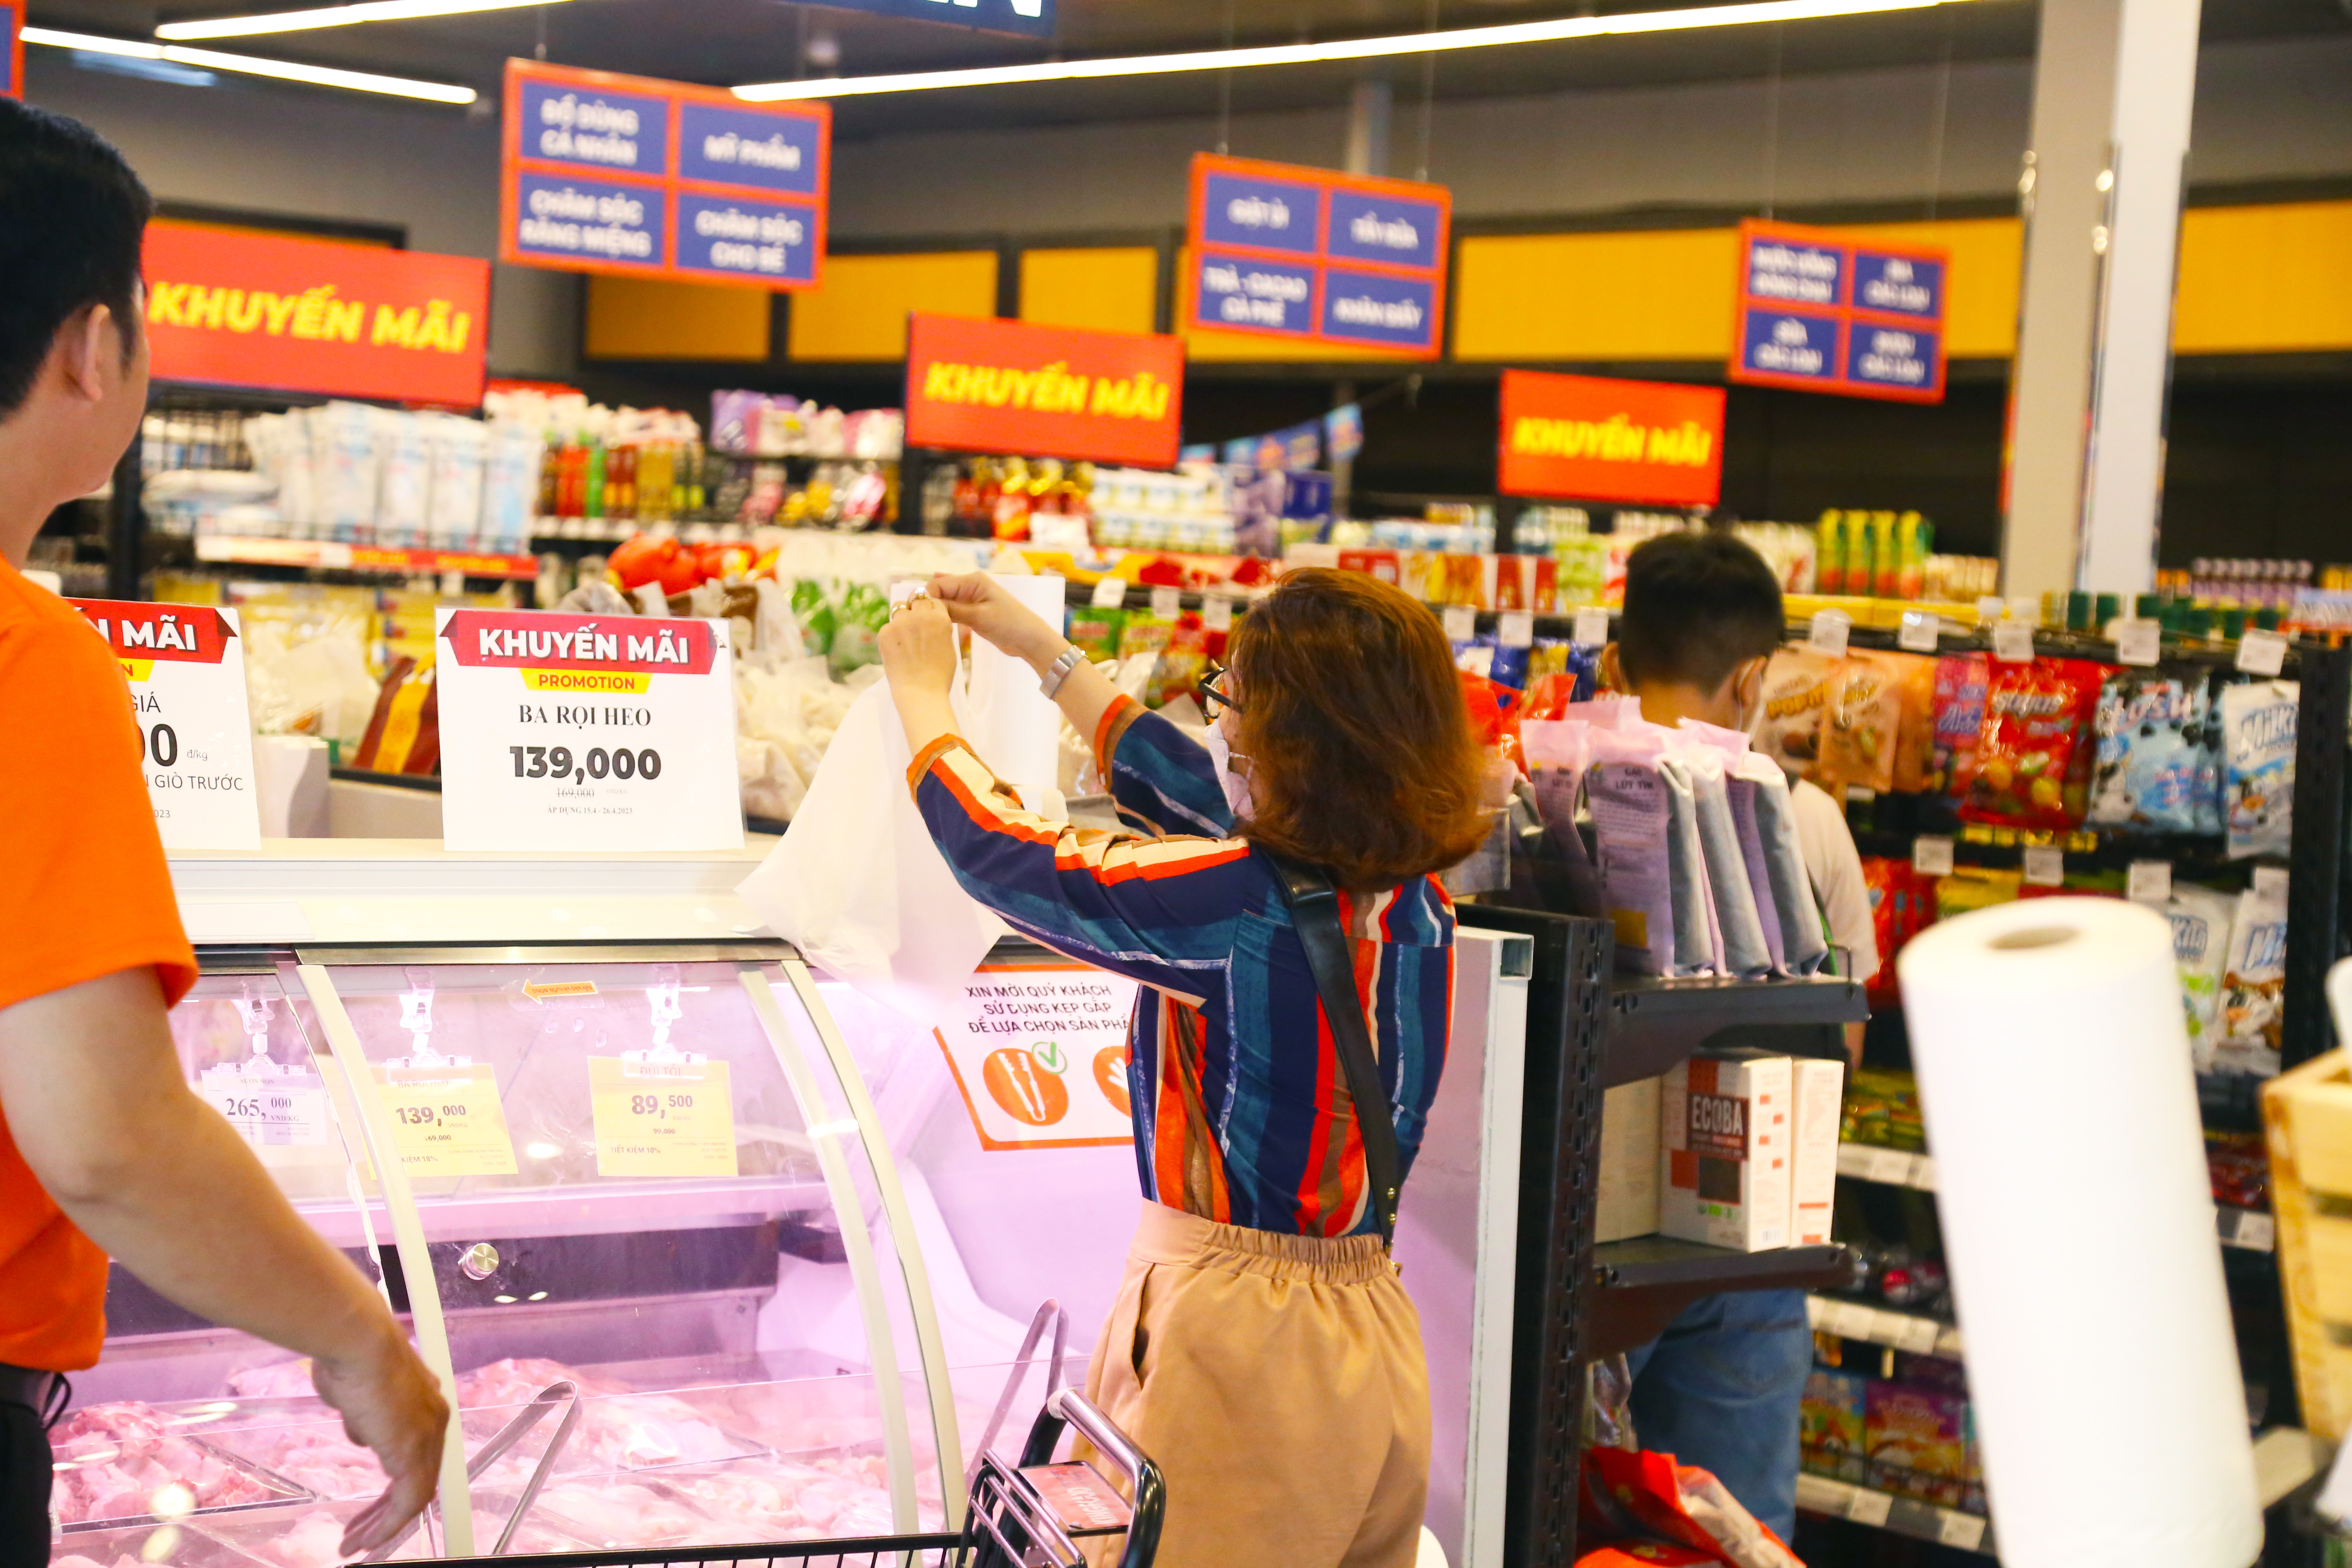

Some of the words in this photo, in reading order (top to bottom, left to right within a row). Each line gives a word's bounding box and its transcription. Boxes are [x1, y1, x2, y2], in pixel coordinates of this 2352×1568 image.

[148, 282, 364, 344] KHUYẾN
[371, 300, 470, 352] MÃI
[925, 361, 1087, 413] KHUYẾN
[1091, 372, 1168, 421] MÃI
[1514, 413, 1645, 462] KHUYẾN
[1649, 421, 1711, 467] MÃI
[122, 614, 196, 651] MÃI
[479, 623, 617, 661] KHUYẾN
[628, 629, 689, 663] MÃI
[539, 674, 635, 689] PROMOTION
[518, 704, 548, 723] BA
[556, 705, 597, 729] RỌI
[604, 707, 651, 726] HEO
[187, 749, 208, 761] đ/kg
[509, 746, 662, 785] 139,000
[155, 772, 183, 788] GIÒ
[187, 774, 243, 791] TRƯỚC
[557, 787, 594, 799] 169,000
[559, 807, 581, 815] DỤNG
[965, 986, 992, 997] XIN
[994, 983, 1025, 997] MỜI
[1028, 982, 1057, 997] QUÝ
[1061, 982, 1112, 996] KHÁCH
[1051, 1003, 1079, 1016] KẸP
[991, 1021, 1022, 1035] LỰA
[1024, 1020, 1068, 1034] CHỌN
[1069, 1016, 1099, 1031] SẢN
[1102, 1014, 1129, 1030] PHẨ
[271, 1097, 291, 1108] 000
[442, 1105, 466, 1116] 000
[669, 1095, 693, 1107] 500
[1692, 1096, 1743, 1136] ECOBA
